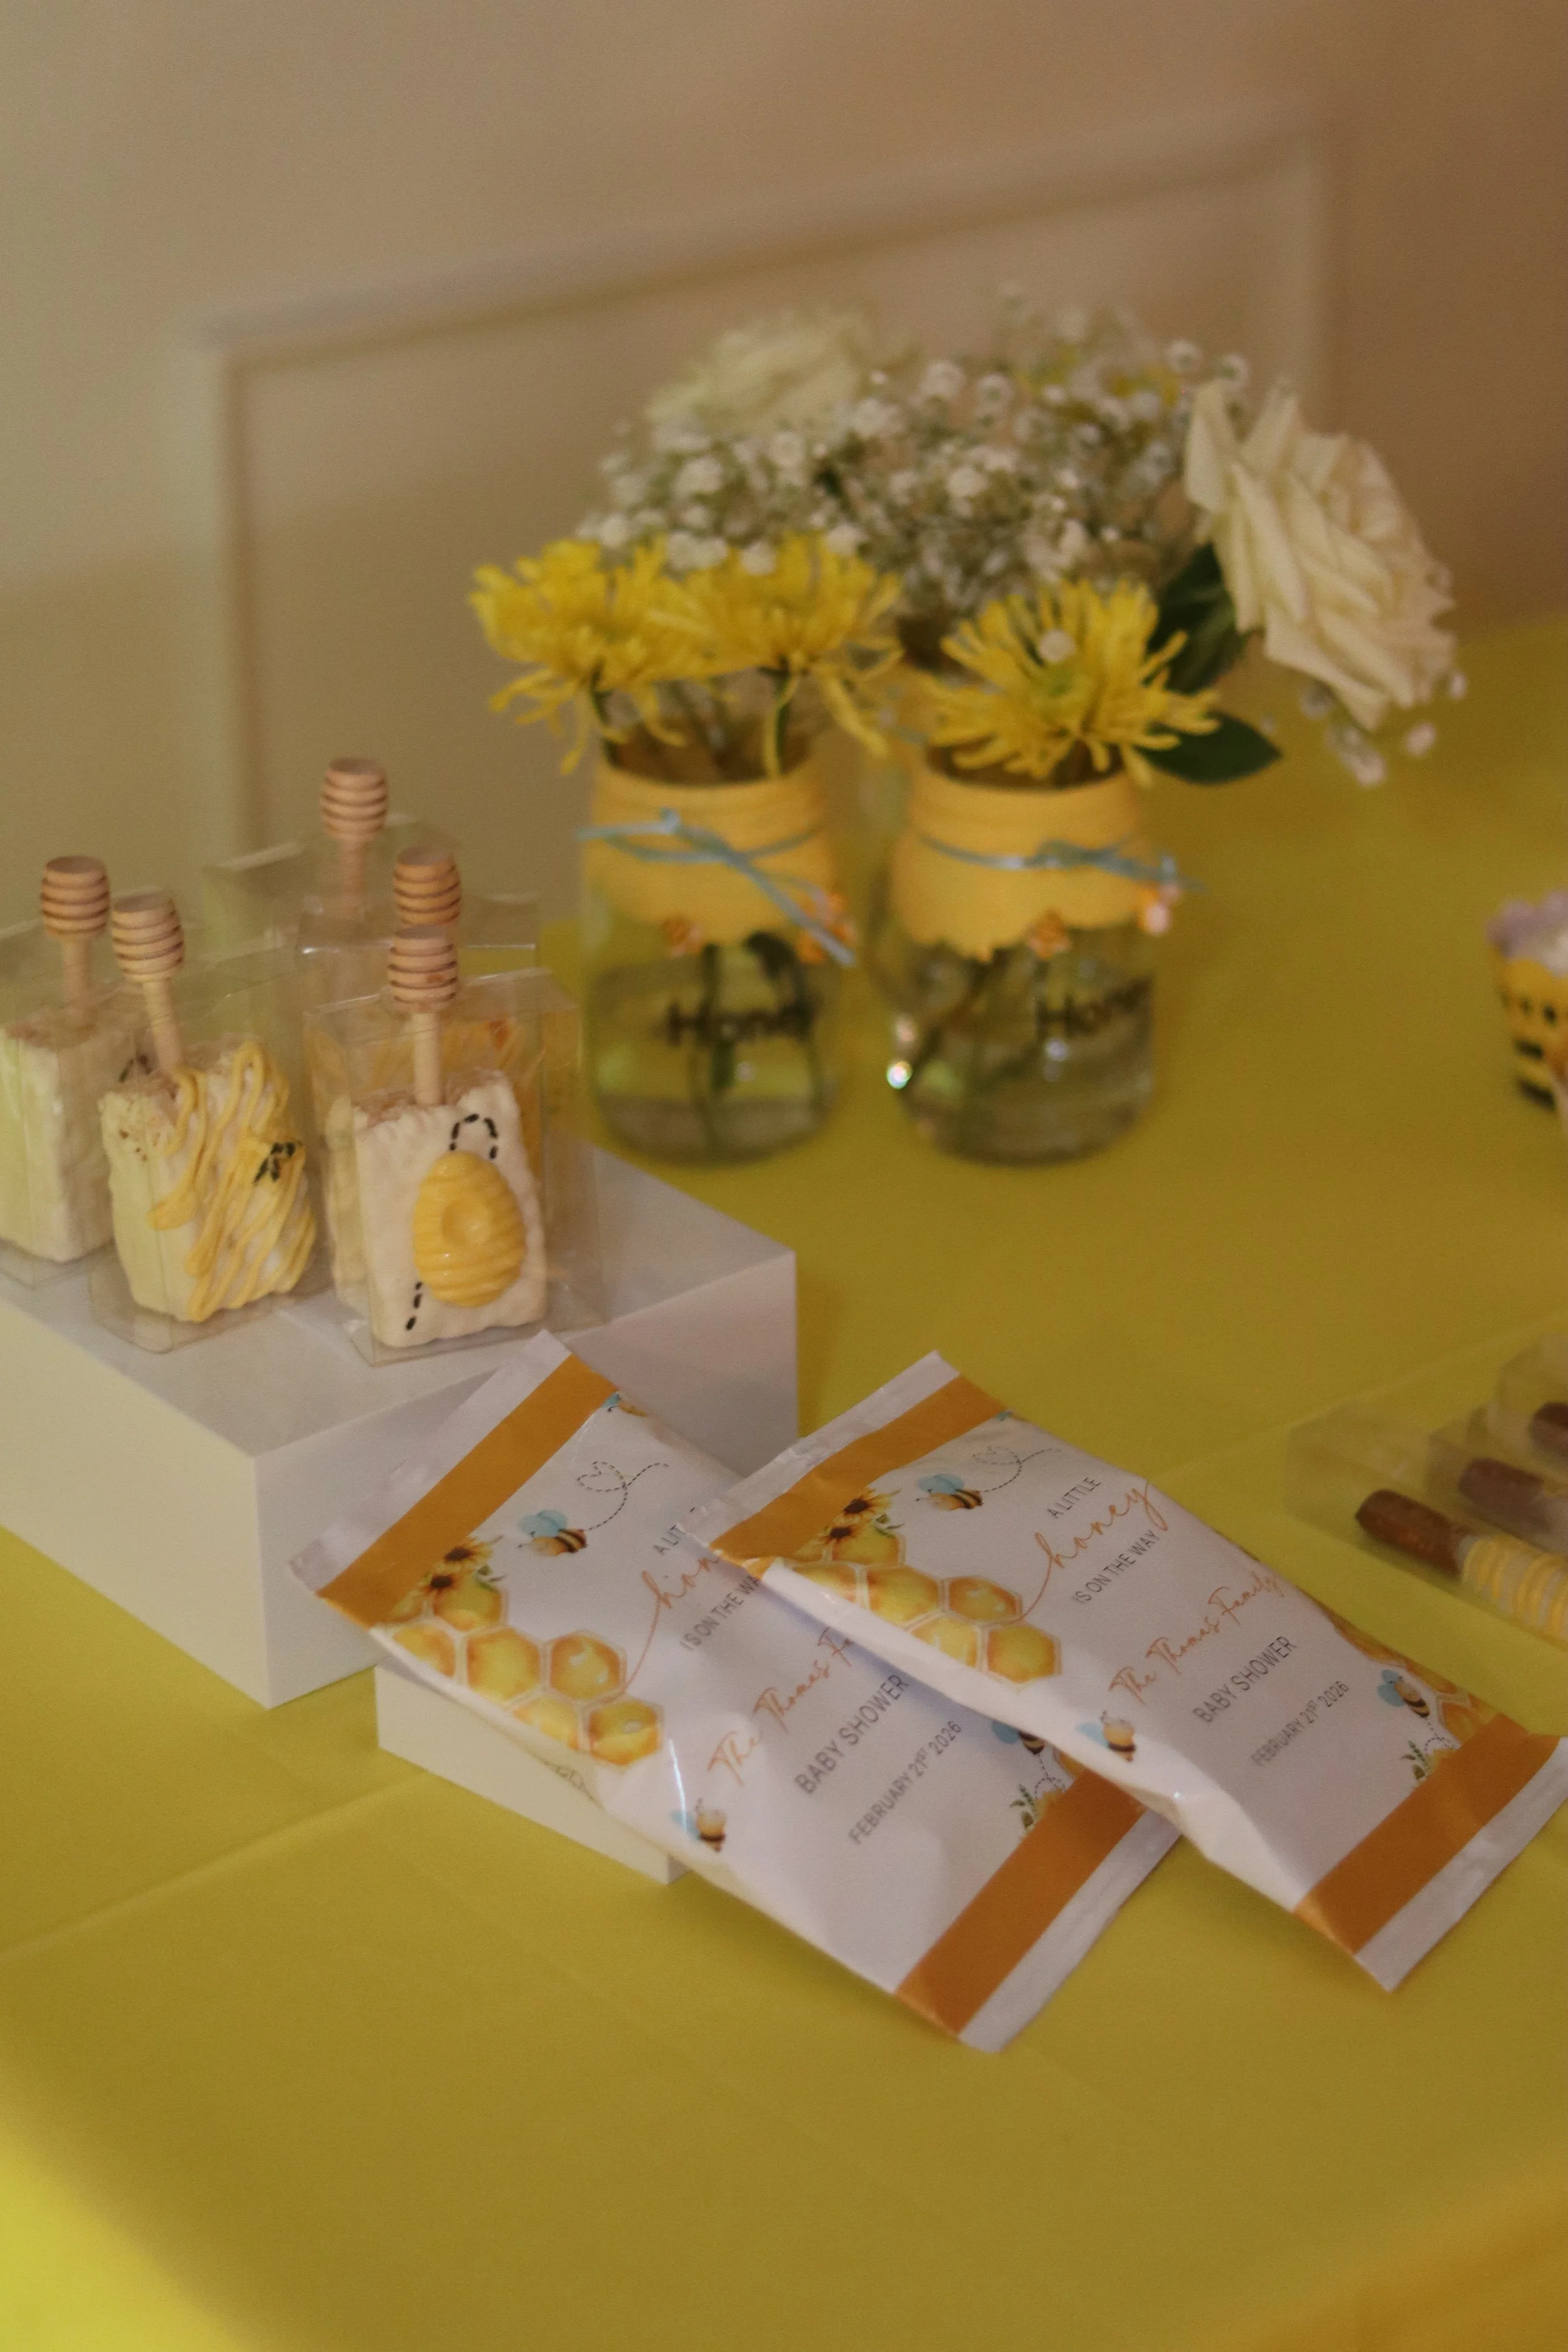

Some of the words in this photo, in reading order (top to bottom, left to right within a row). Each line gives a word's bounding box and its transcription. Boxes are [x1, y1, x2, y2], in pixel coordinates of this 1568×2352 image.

[1034, 1481, 1168, 1569] honey
[1047, 1508, 1064, 1519] A
[1056, 1477, 1101, 1511] LITTLE
[642, 1557, 720, 1609] hon
[653, 1543, 670, 1556] A
[1071, 1591, 1093, 1604] IS
[1085, 1573, 1112, 1593] ON
[1103, 1553, 1136, 1576] THE
[1127, 1529, 1160, 1556] WAY
[680, 1631, 702, 1651] IS
[694, 1616, 720, 1637] ON
[710, 1592, 744, 1619] THE
[737, 1575, 760, 1596] WA
[1108, 1666, 1158, 1705] The
[1145, 1616, 1219, 1676] Thomas
[1192, 1683, 1238, 1724] BABY
[1230, 1636, 1297, 1691] SHOWER
[794, 1739, 845, 1794] BABY
[838, 1675, 910, 1746] SHOWER
[1251, 1718, 1305, 1767] FEBRUARY
[1318, 1680, 1349, 1708] 2026
[848, 1772, 914, 1845] FEBRUARY
[928, 1720, 962, 1756] 2026
